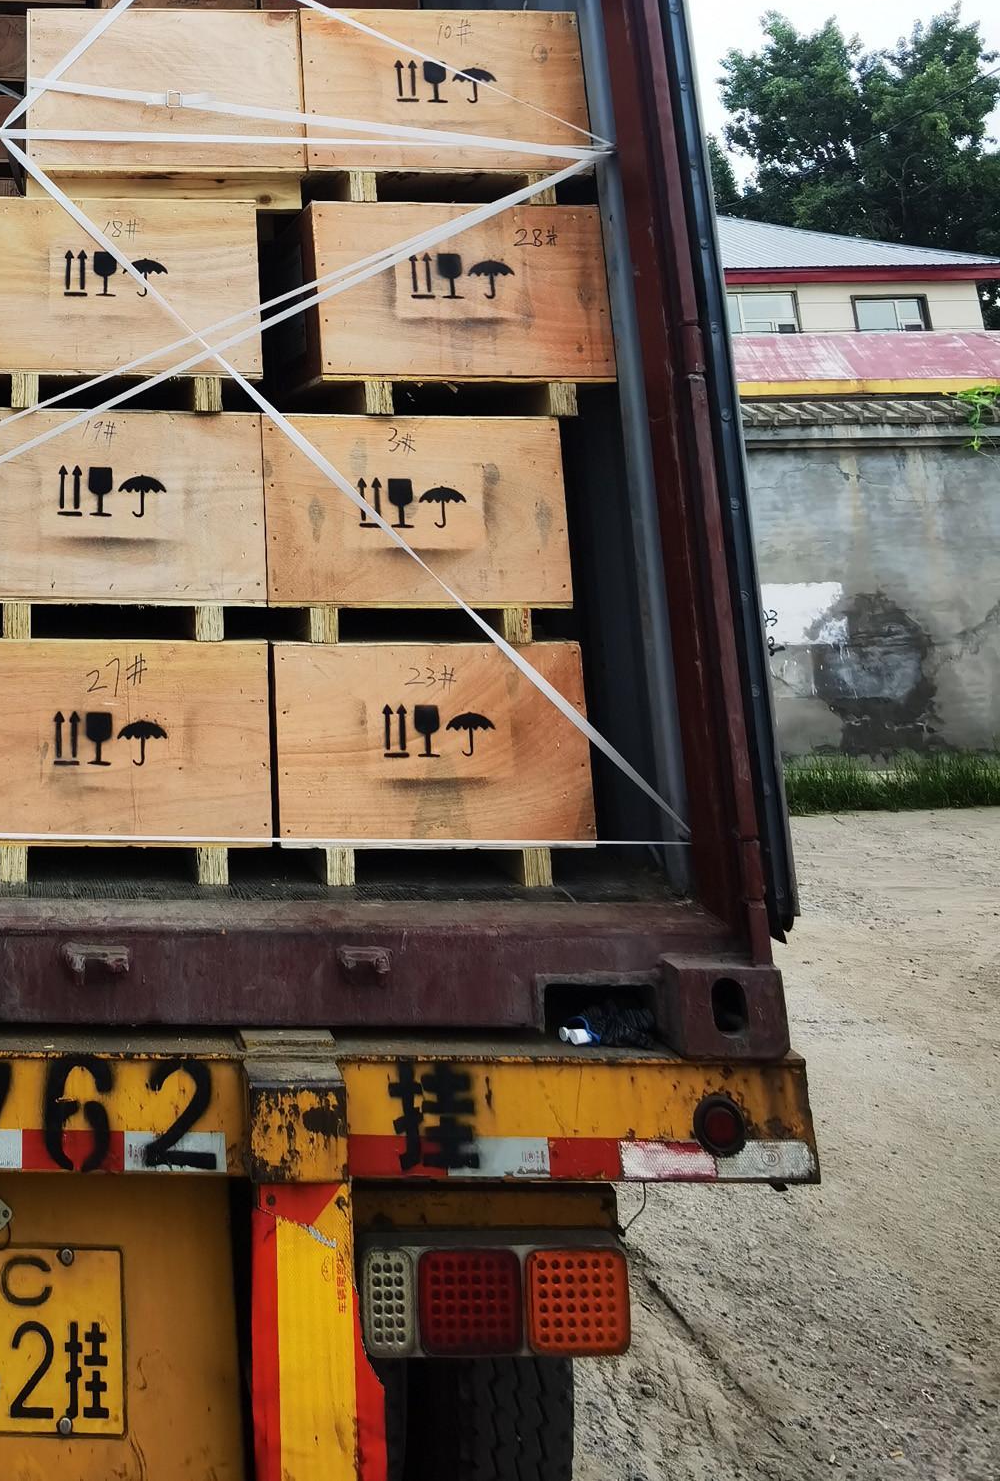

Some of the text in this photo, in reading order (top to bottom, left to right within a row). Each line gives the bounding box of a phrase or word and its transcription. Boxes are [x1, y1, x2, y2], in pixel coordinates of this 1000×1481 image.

[436, 18, 474, 47] 10#
[102, 218, 142, 242] 18#
[513, 225, 558, 247] 28#
[82, 420, 117, 447] 19#
[387, 427, 416, 454] 3#
[85, 652, 148, 697] 27#
[403, 664, 457, 694] 23#
